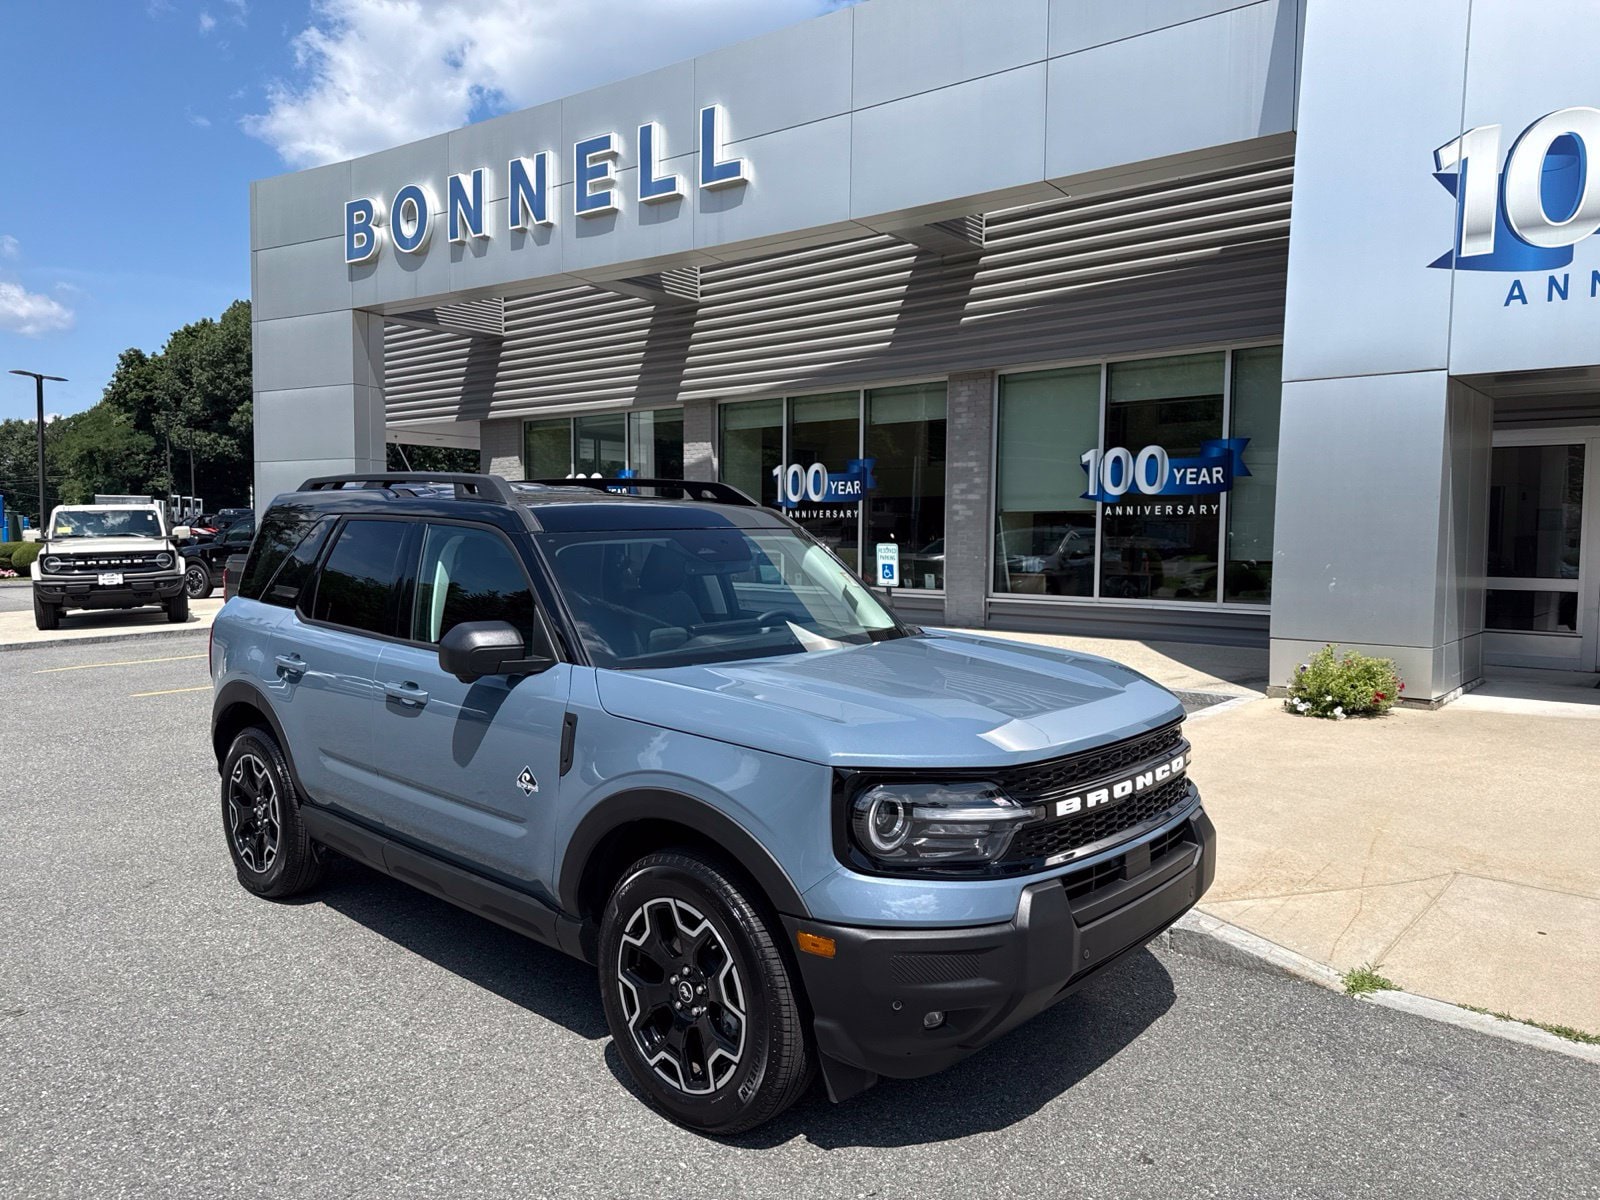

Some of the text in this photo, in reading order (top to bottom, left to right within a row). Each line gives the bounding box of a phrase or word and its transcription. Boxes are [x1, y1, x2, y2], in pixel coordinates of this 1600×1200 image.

[345, 103, 749, 264] BONNELL
[772, 462, 861, 503] 100 YEAR
[1081, 445, 1225, 496] 100 YEAR
[788, 510, 859, 519] ANNIVERSARY
[1105, 504, 1219, 516] ANNIVERSARY
[1056, 756, 1184, 817] BRONCO
